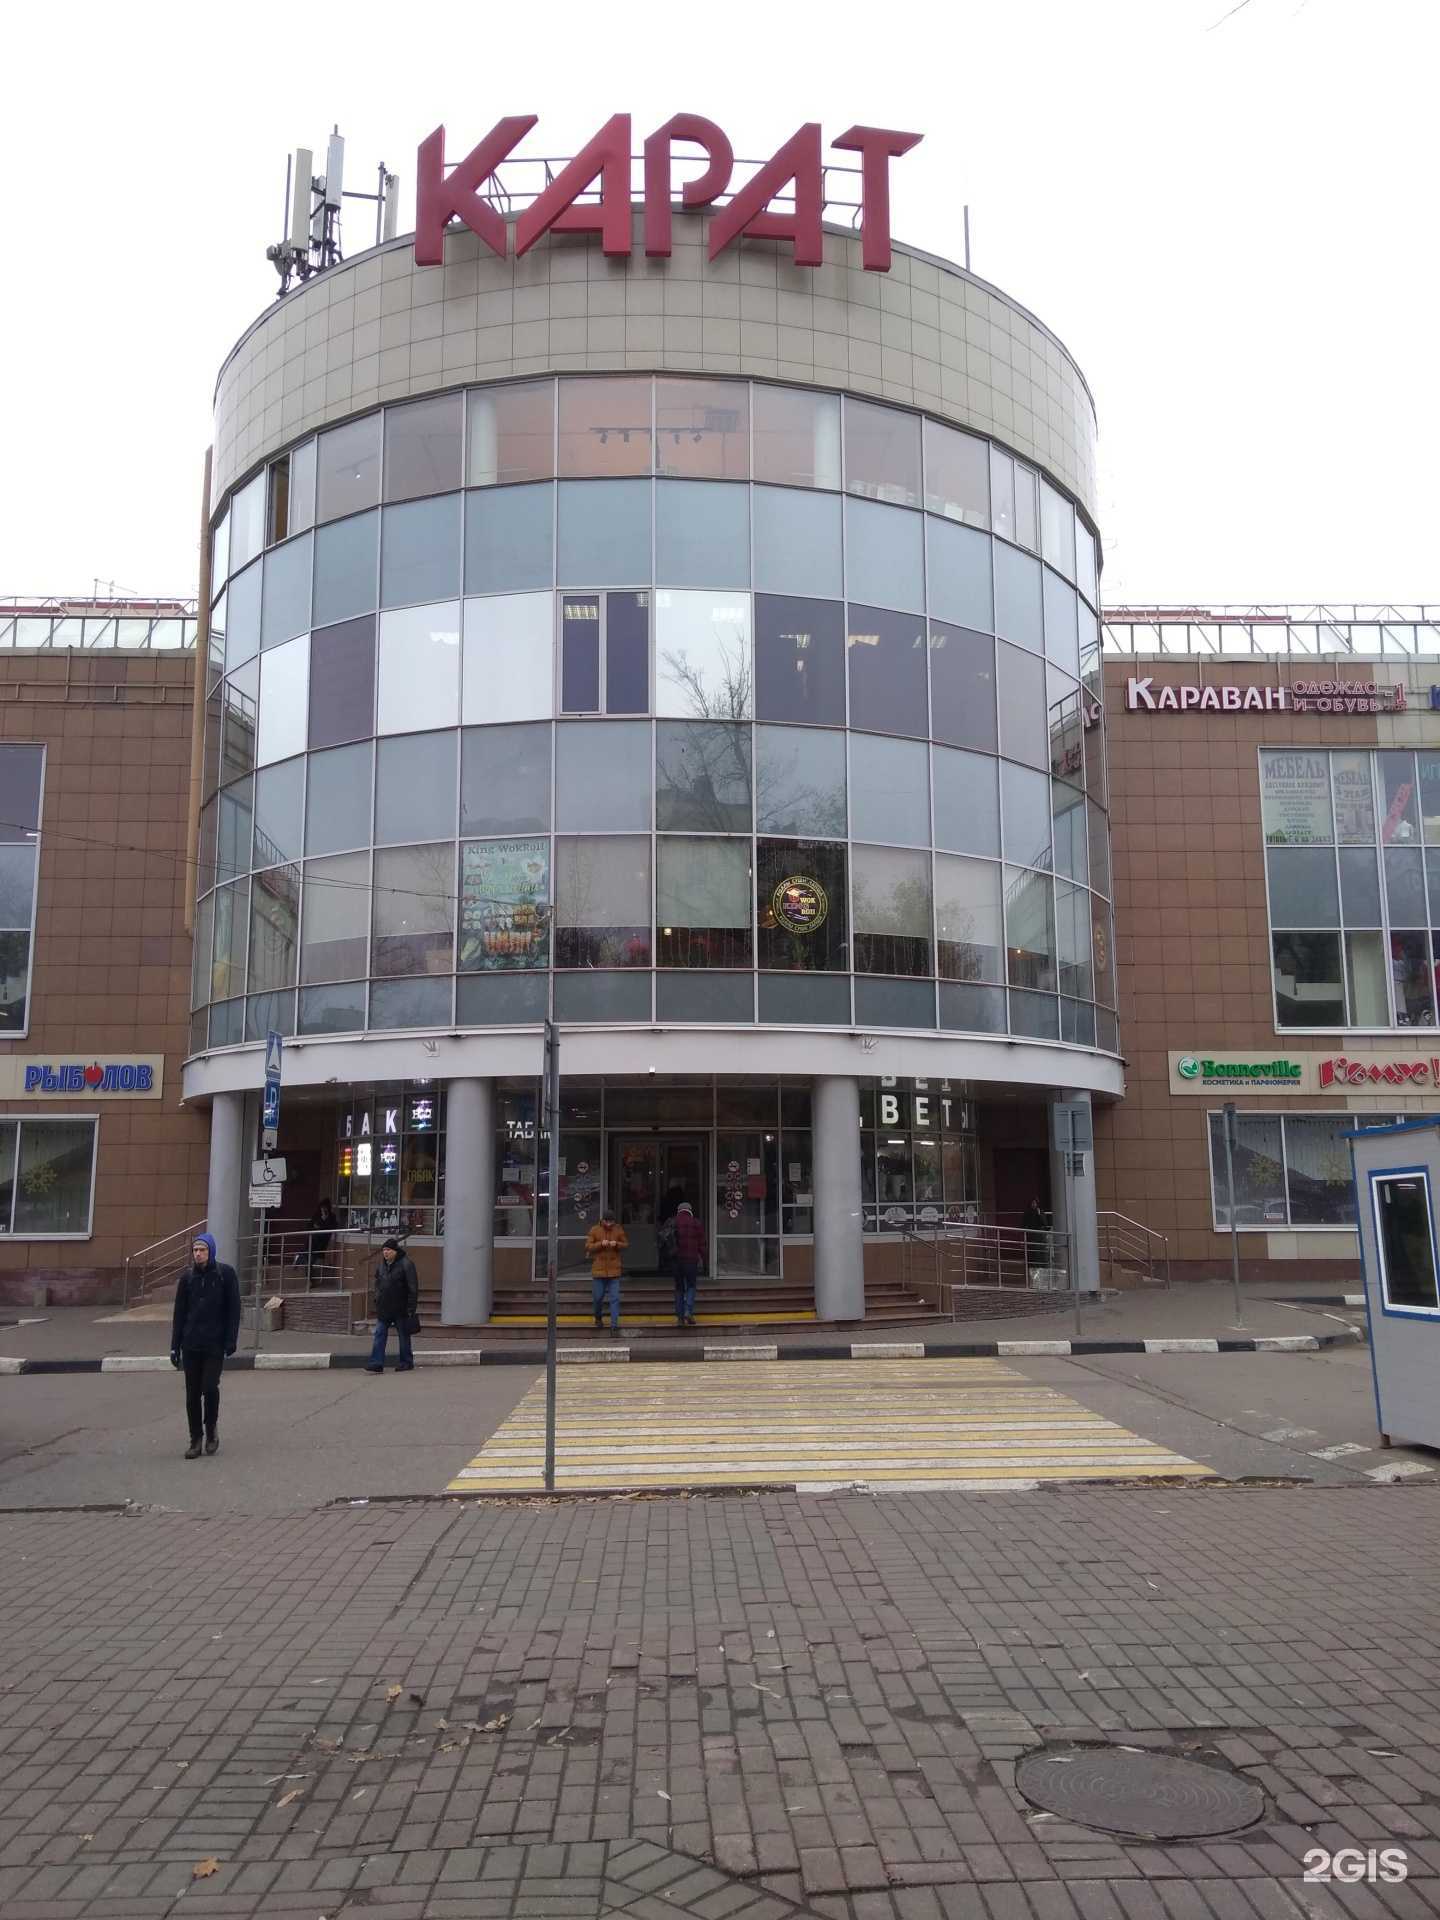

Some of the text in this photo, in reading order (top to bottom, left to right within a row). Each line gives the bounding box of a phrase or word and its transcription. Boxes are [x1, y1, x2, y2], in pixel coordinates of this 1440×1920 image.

[415, 112, 924, 272] КАРАТ
[1126, 677, 1285, 710] КАРАВАН
[1293, 698, 1307, 712] И
[1317, 697, 1381, 713] ОБУВЬ
[1264, 755, 1326, 779] МЕБЕЛЬ
[1200, 1060, 1302, 1078] Bonneville
